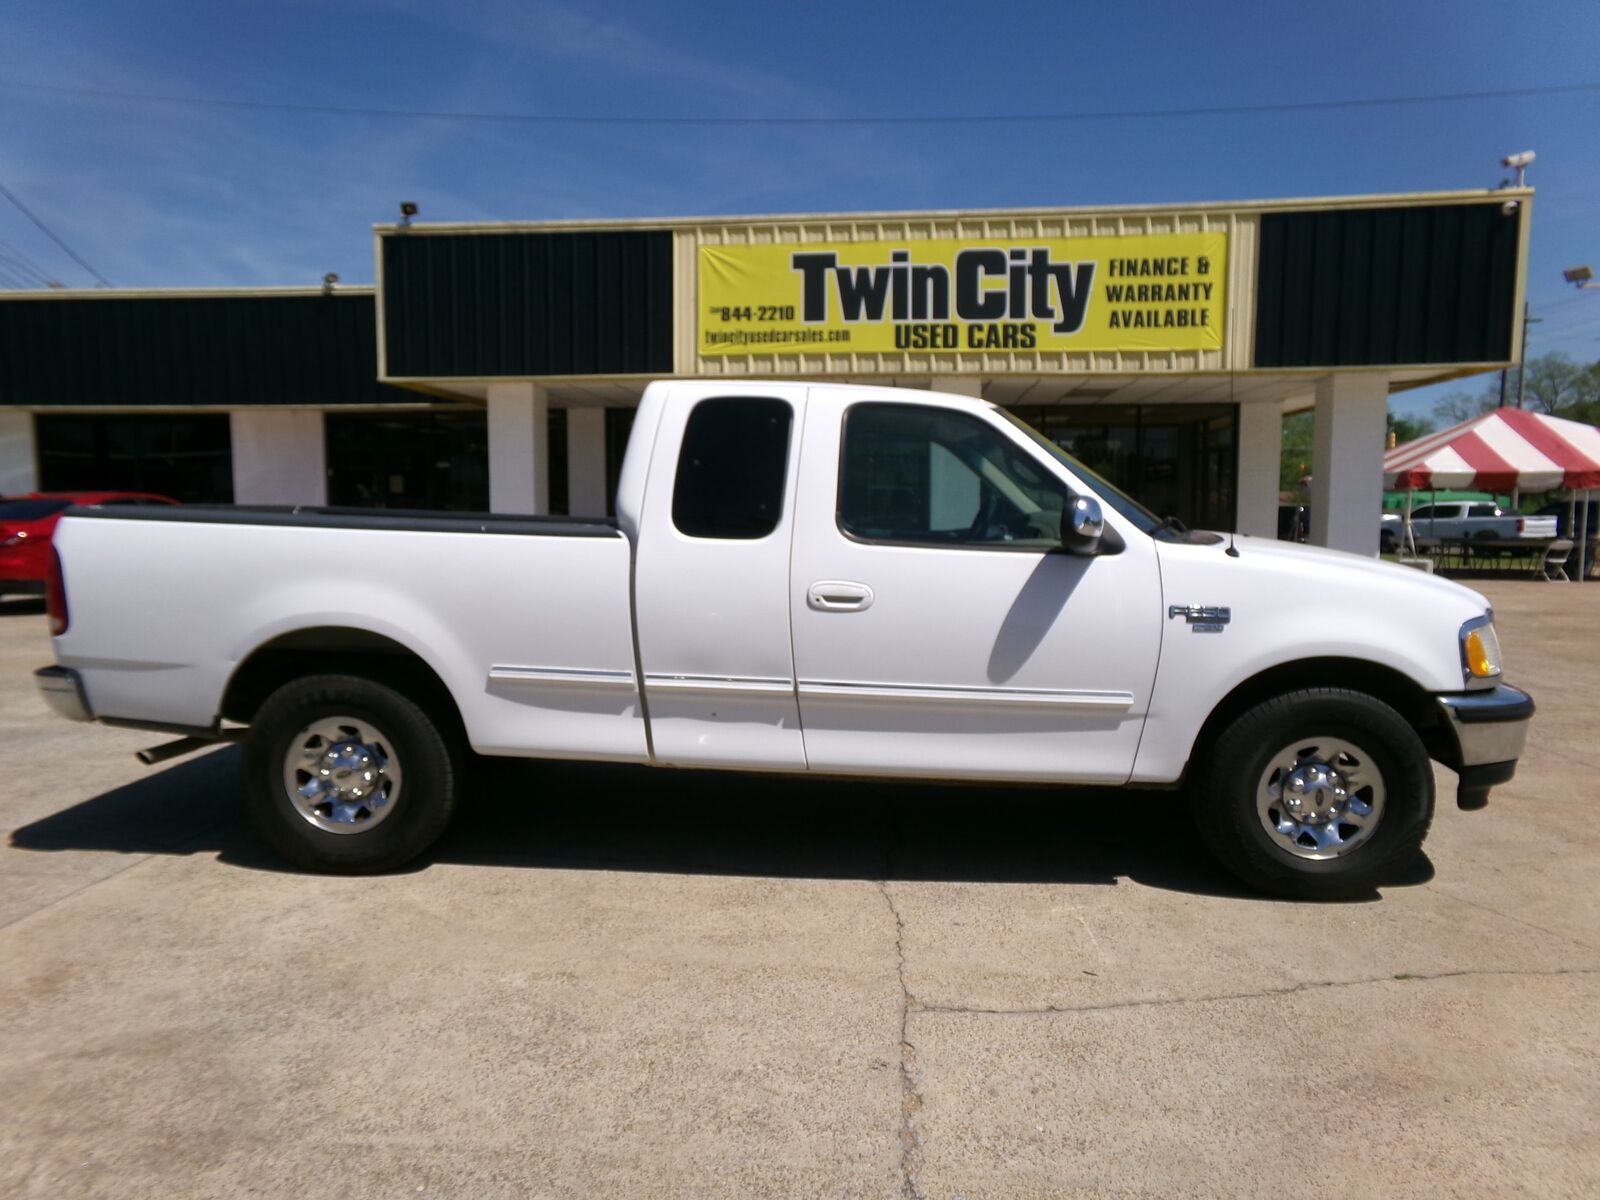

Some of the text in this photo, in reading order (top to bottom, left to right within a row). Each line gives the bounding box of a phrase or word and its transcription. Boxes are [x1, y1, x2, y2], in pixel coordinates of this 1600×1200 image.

[1109, 256, 1210, 277] FINANCE &
[1106, 283, 1213, 302] WARRANTY
[1109, 309, 1209, 328] AVAILABLE
[705, 329, 851, 345] twincityusedcarsales.com
[895, 322, 1036, 349] USED CARS
